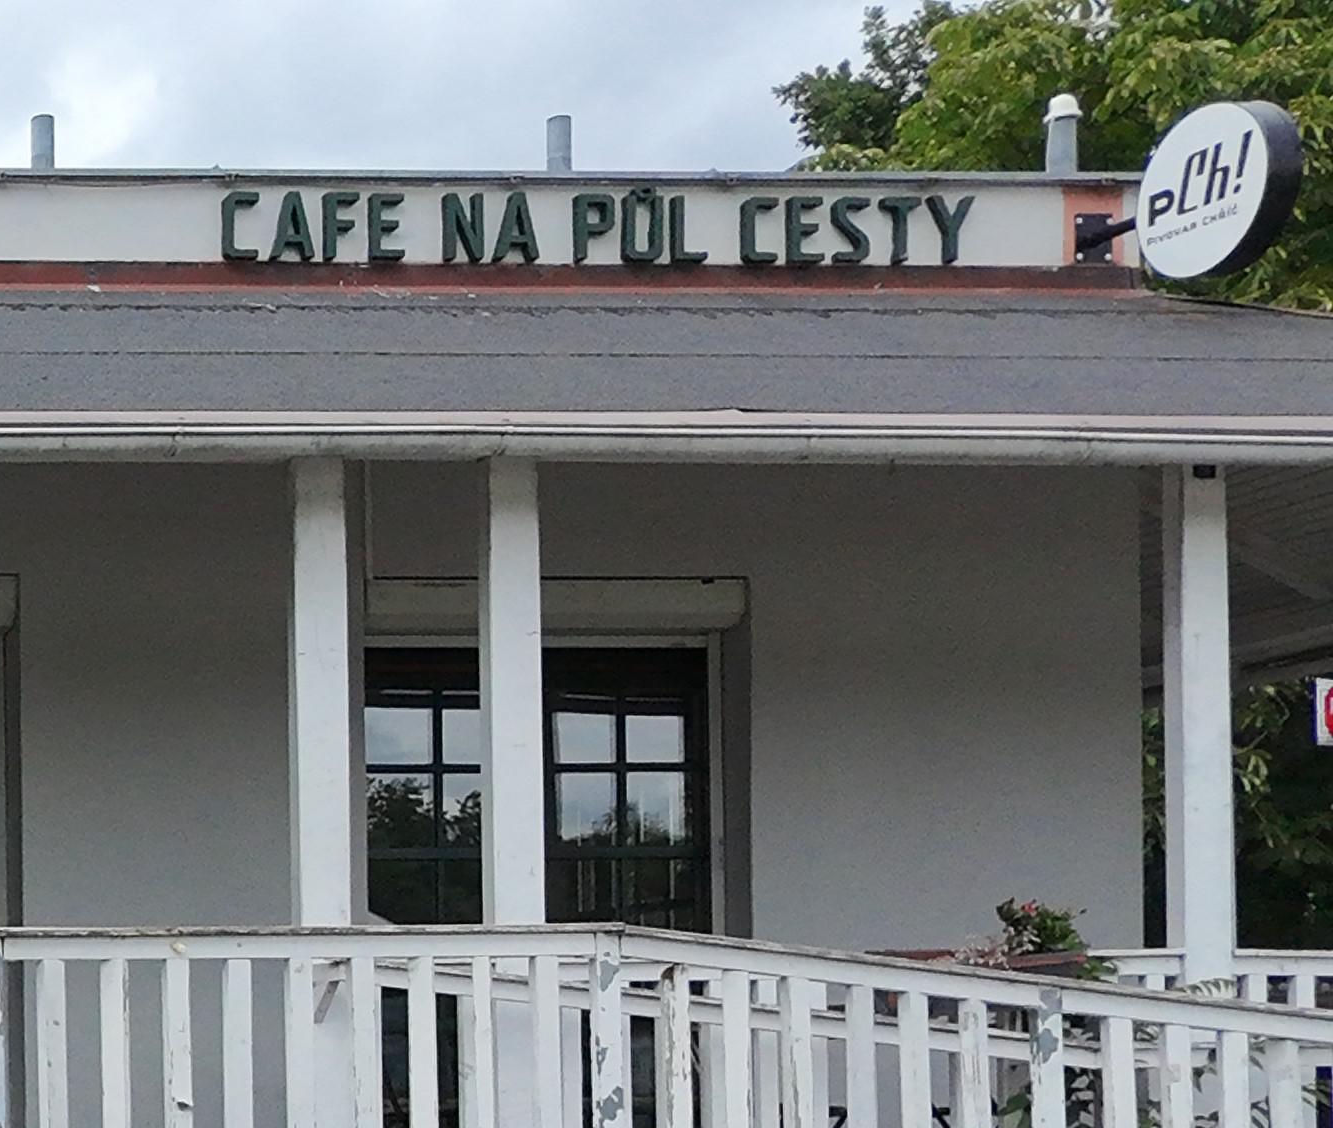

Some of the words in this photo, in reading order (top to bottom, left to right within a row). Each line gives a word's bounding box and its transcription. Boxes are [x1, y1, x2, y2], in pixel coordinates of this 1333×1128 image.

[221, 190, 406, 262] CAFE
[441, 190, 540, 263] NA
[739, 194, 976, 265] CESTY
